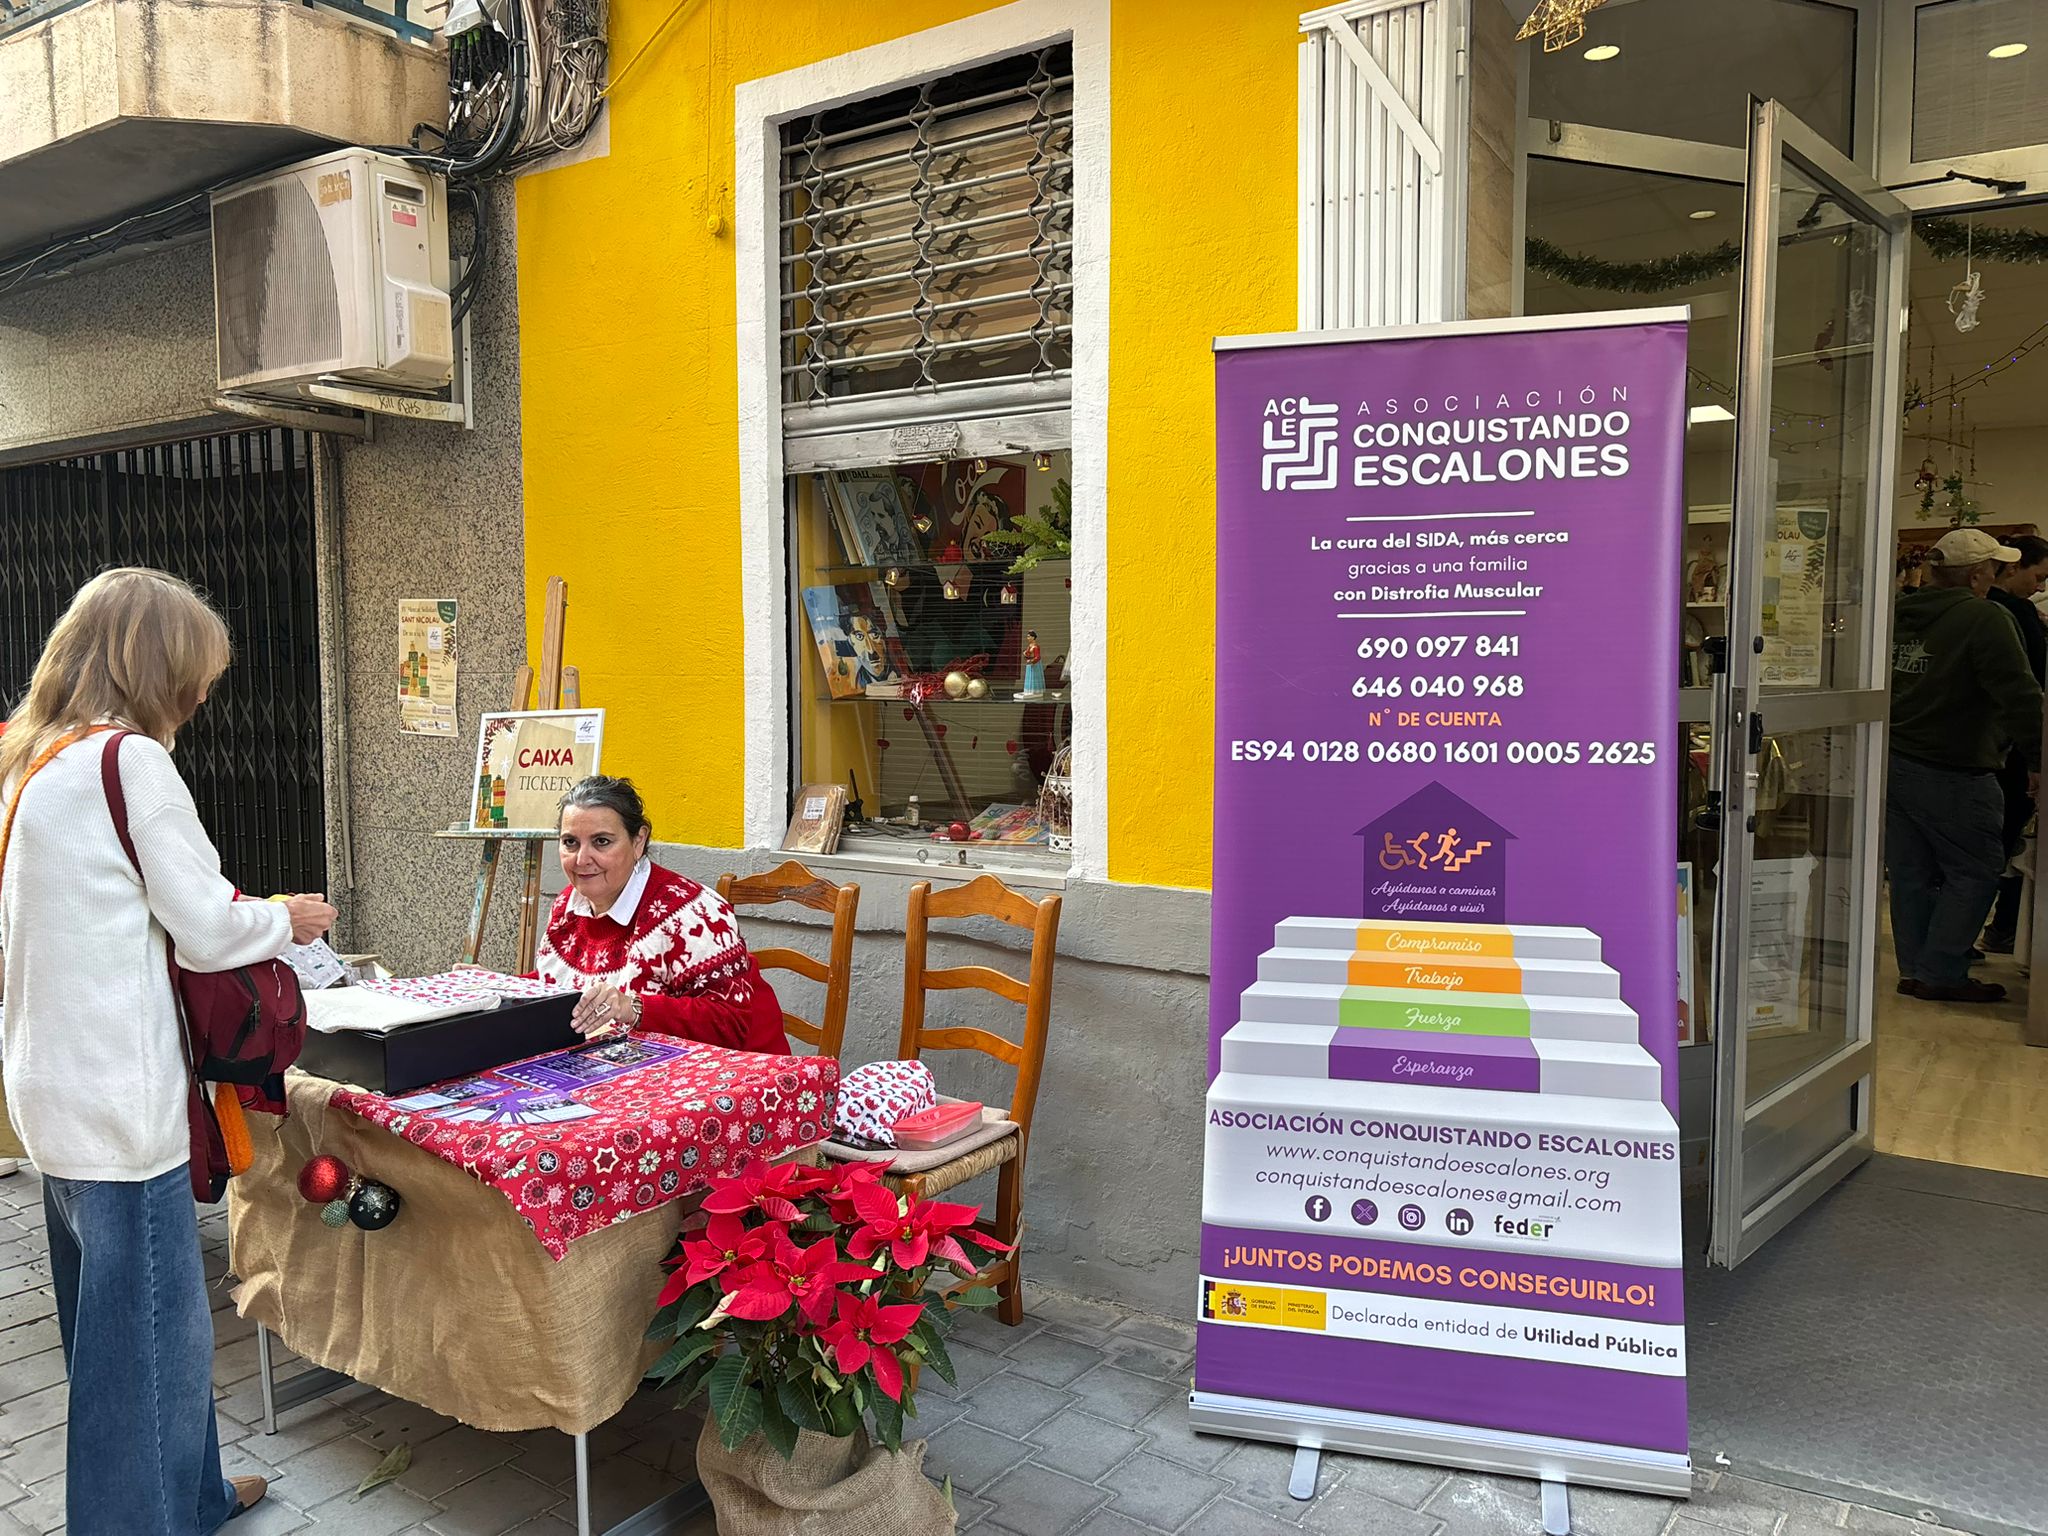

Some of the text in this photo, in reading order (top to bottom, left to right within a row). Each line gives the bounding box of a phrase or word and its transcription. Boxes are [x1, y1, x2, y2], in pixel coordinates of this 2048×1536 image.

[1357, 385, 1629, 421] ASOCIACIÓN
[1353, 411, 1629, 453] CONQUISTANDO
[1353, 438, 1629, 486] ESCALONES
[1312, 530, 1568, 550] La cura del SIDA, más cerca
[1777, 530, 1800, 540] OLAU
[1349, 555, 1527, 579] gracias a una familia
[1334, 582, 1543, 600] con Distrofia Muscular
[1358, 636, 1518, 658] 690 097 841
[1352, 676, 1523, 697] 646 040 968
[1399, 713, 1419, 726] DE
[1426, 712, 1501, 726] CUENTA
[518, 748, 574, 768] CAIXA
[1232, 741, 1655, 765] ES94 0128 0680 1601 0005 2625
[518, 775, 573, 791] TICKETS
[1371, 881, 1496, 896] Ayúdanos a caminar
[1382, 898, 1484, 914] Ayúdanos a vivir
[1386, 932, 1483, 953] Compromiso
[1404, 967, 1464, 990] Trabajo
[1406, 1008, 1461, 1031] Fuerza
[1392, 1056, 1473, 1081] Esperanza
[1209, 1109, 1674, 1160] ASOCIACIÓN CONQUISTANDO ESCALONES
[1266, 1144, 1611, 1189] www.conquistandoescalones.org
[1256, 1168, 1622, 1214] conquistandoescalones@gmail.com
[1494, 1215, 1553, 1238] feder
[1224, 1247, 1654, 1306] ¡JUNTOS PODEMOS CONSEGUIRLO!
[1332, 1306, 1677, 1357] Declarada entidad de Utilidad Pública
